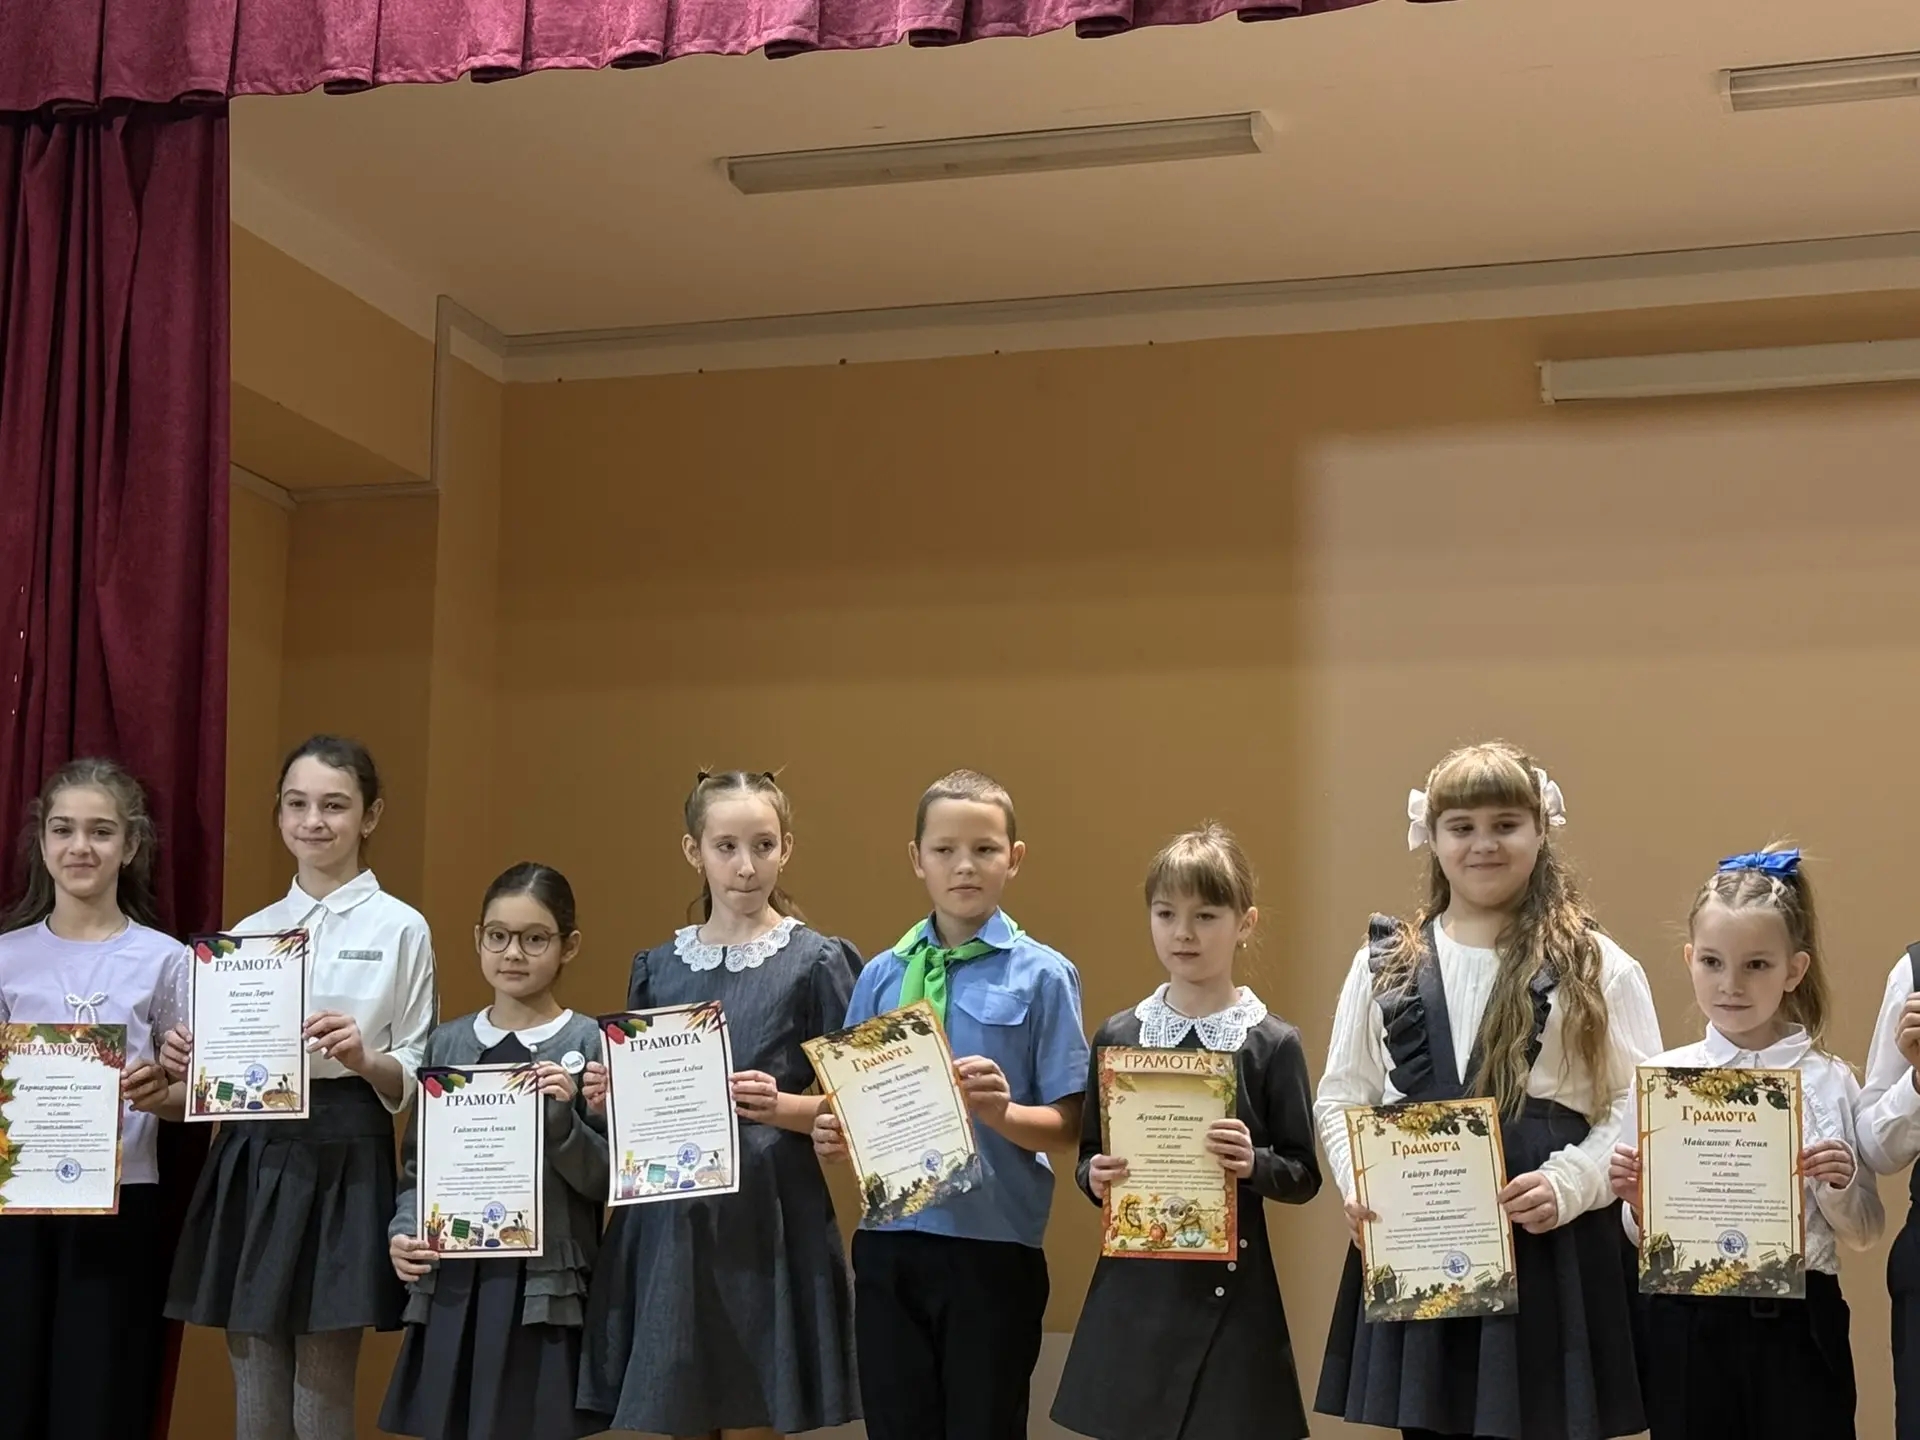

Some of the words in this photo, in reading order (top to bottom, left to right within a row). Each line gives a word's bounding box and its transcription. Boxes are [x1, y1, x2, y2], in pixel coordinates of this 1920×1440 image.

[215, 958, 283, 972] ГРАМОТА
[630, 1032, 702, 1052] ГРАМОТА
[16, 1042, 100, 1057] ГРАМОТА
[851, 1043, 913, 1074] Грамота
[1124, 1054, 1206, 1070] ГРАМОТА
[69, 1083, 102, 1092] Сусанна
[445, 1093, 516, 1107] ГРАМОТА
[1136, 1113, 1166, 1123] Жукова
[1168, 1113, 1204, 1122] Татьяна
[1681, 1105, 1757, 1125] Грамота
[1391, 1139, 1461, 1159] Грамота
[1735, 1138, 1768, 1148] Ксения
[1401, 1171, 1431, 1179] Гайдук
[1433, 1168, 1467, 1178] Варвара
